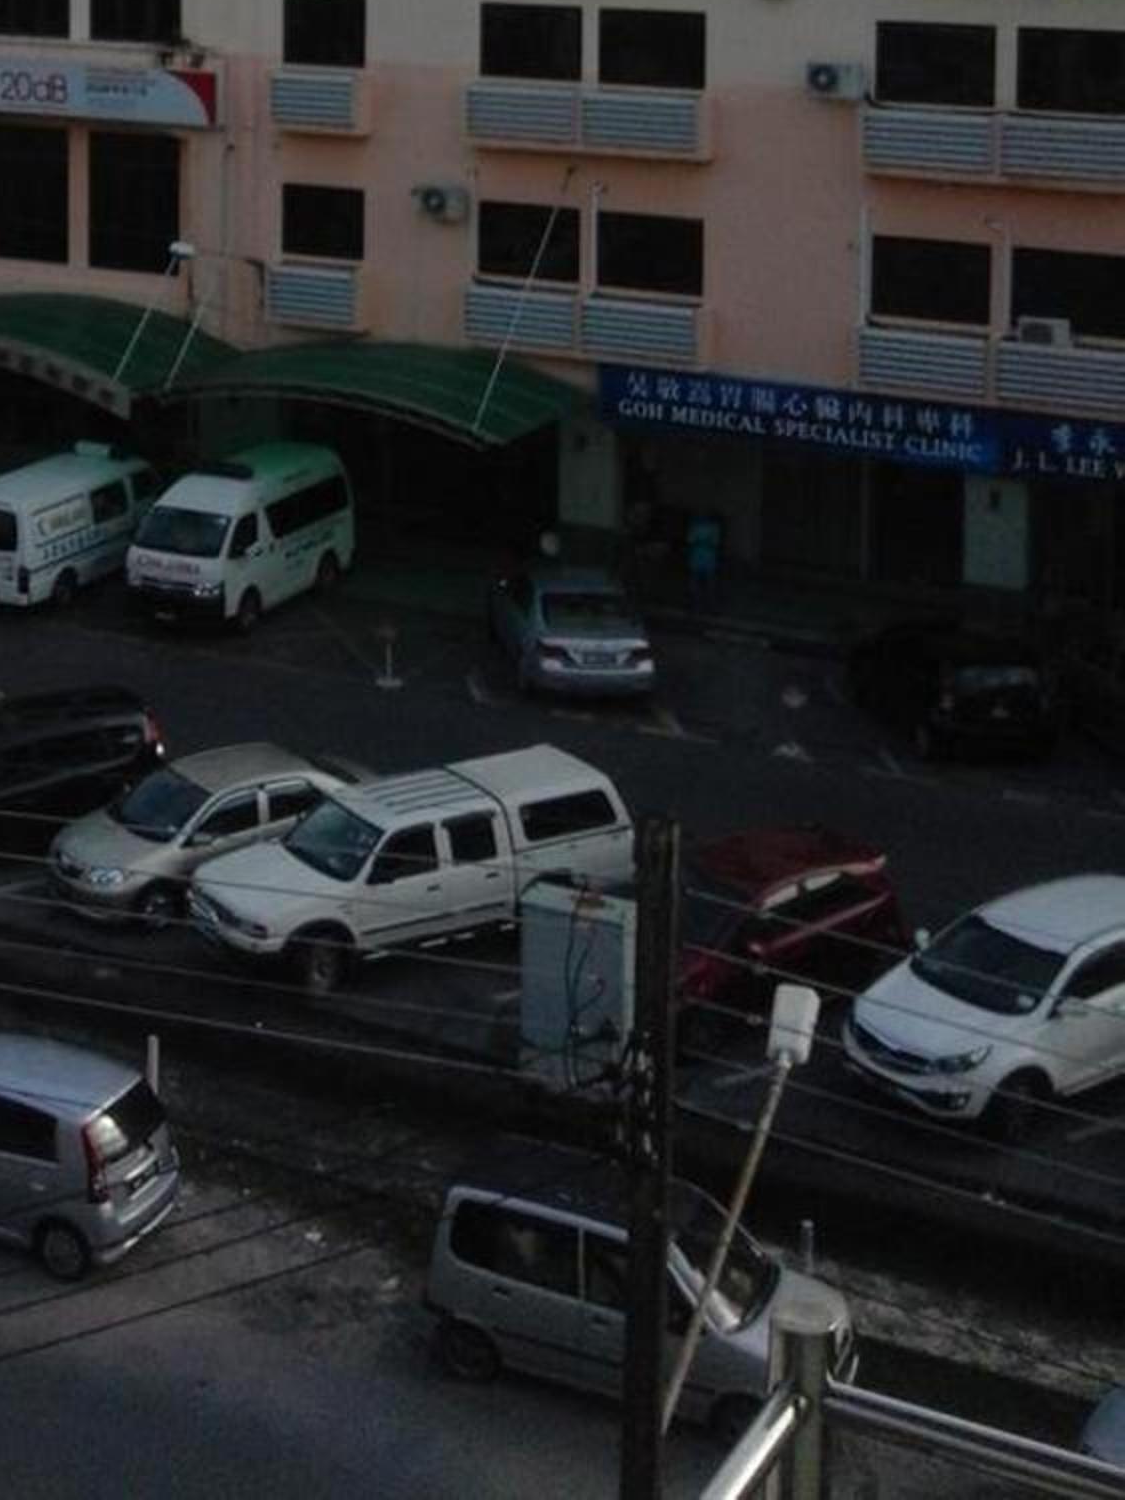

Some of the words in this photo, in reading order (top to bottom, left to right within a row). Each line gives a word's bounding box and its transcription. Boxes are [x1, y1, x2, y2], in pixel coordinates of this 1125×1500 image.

[0, 70, 68, 104] 20dB
[618, 398, 663, 421] GOH
[671, 404, 767, 434] MEDICAL
[775, 419, 895, 450] SPECIALIST
[903, 436, 984, 463] CLINIC
[1066, 455, 1107, 479] LEE
